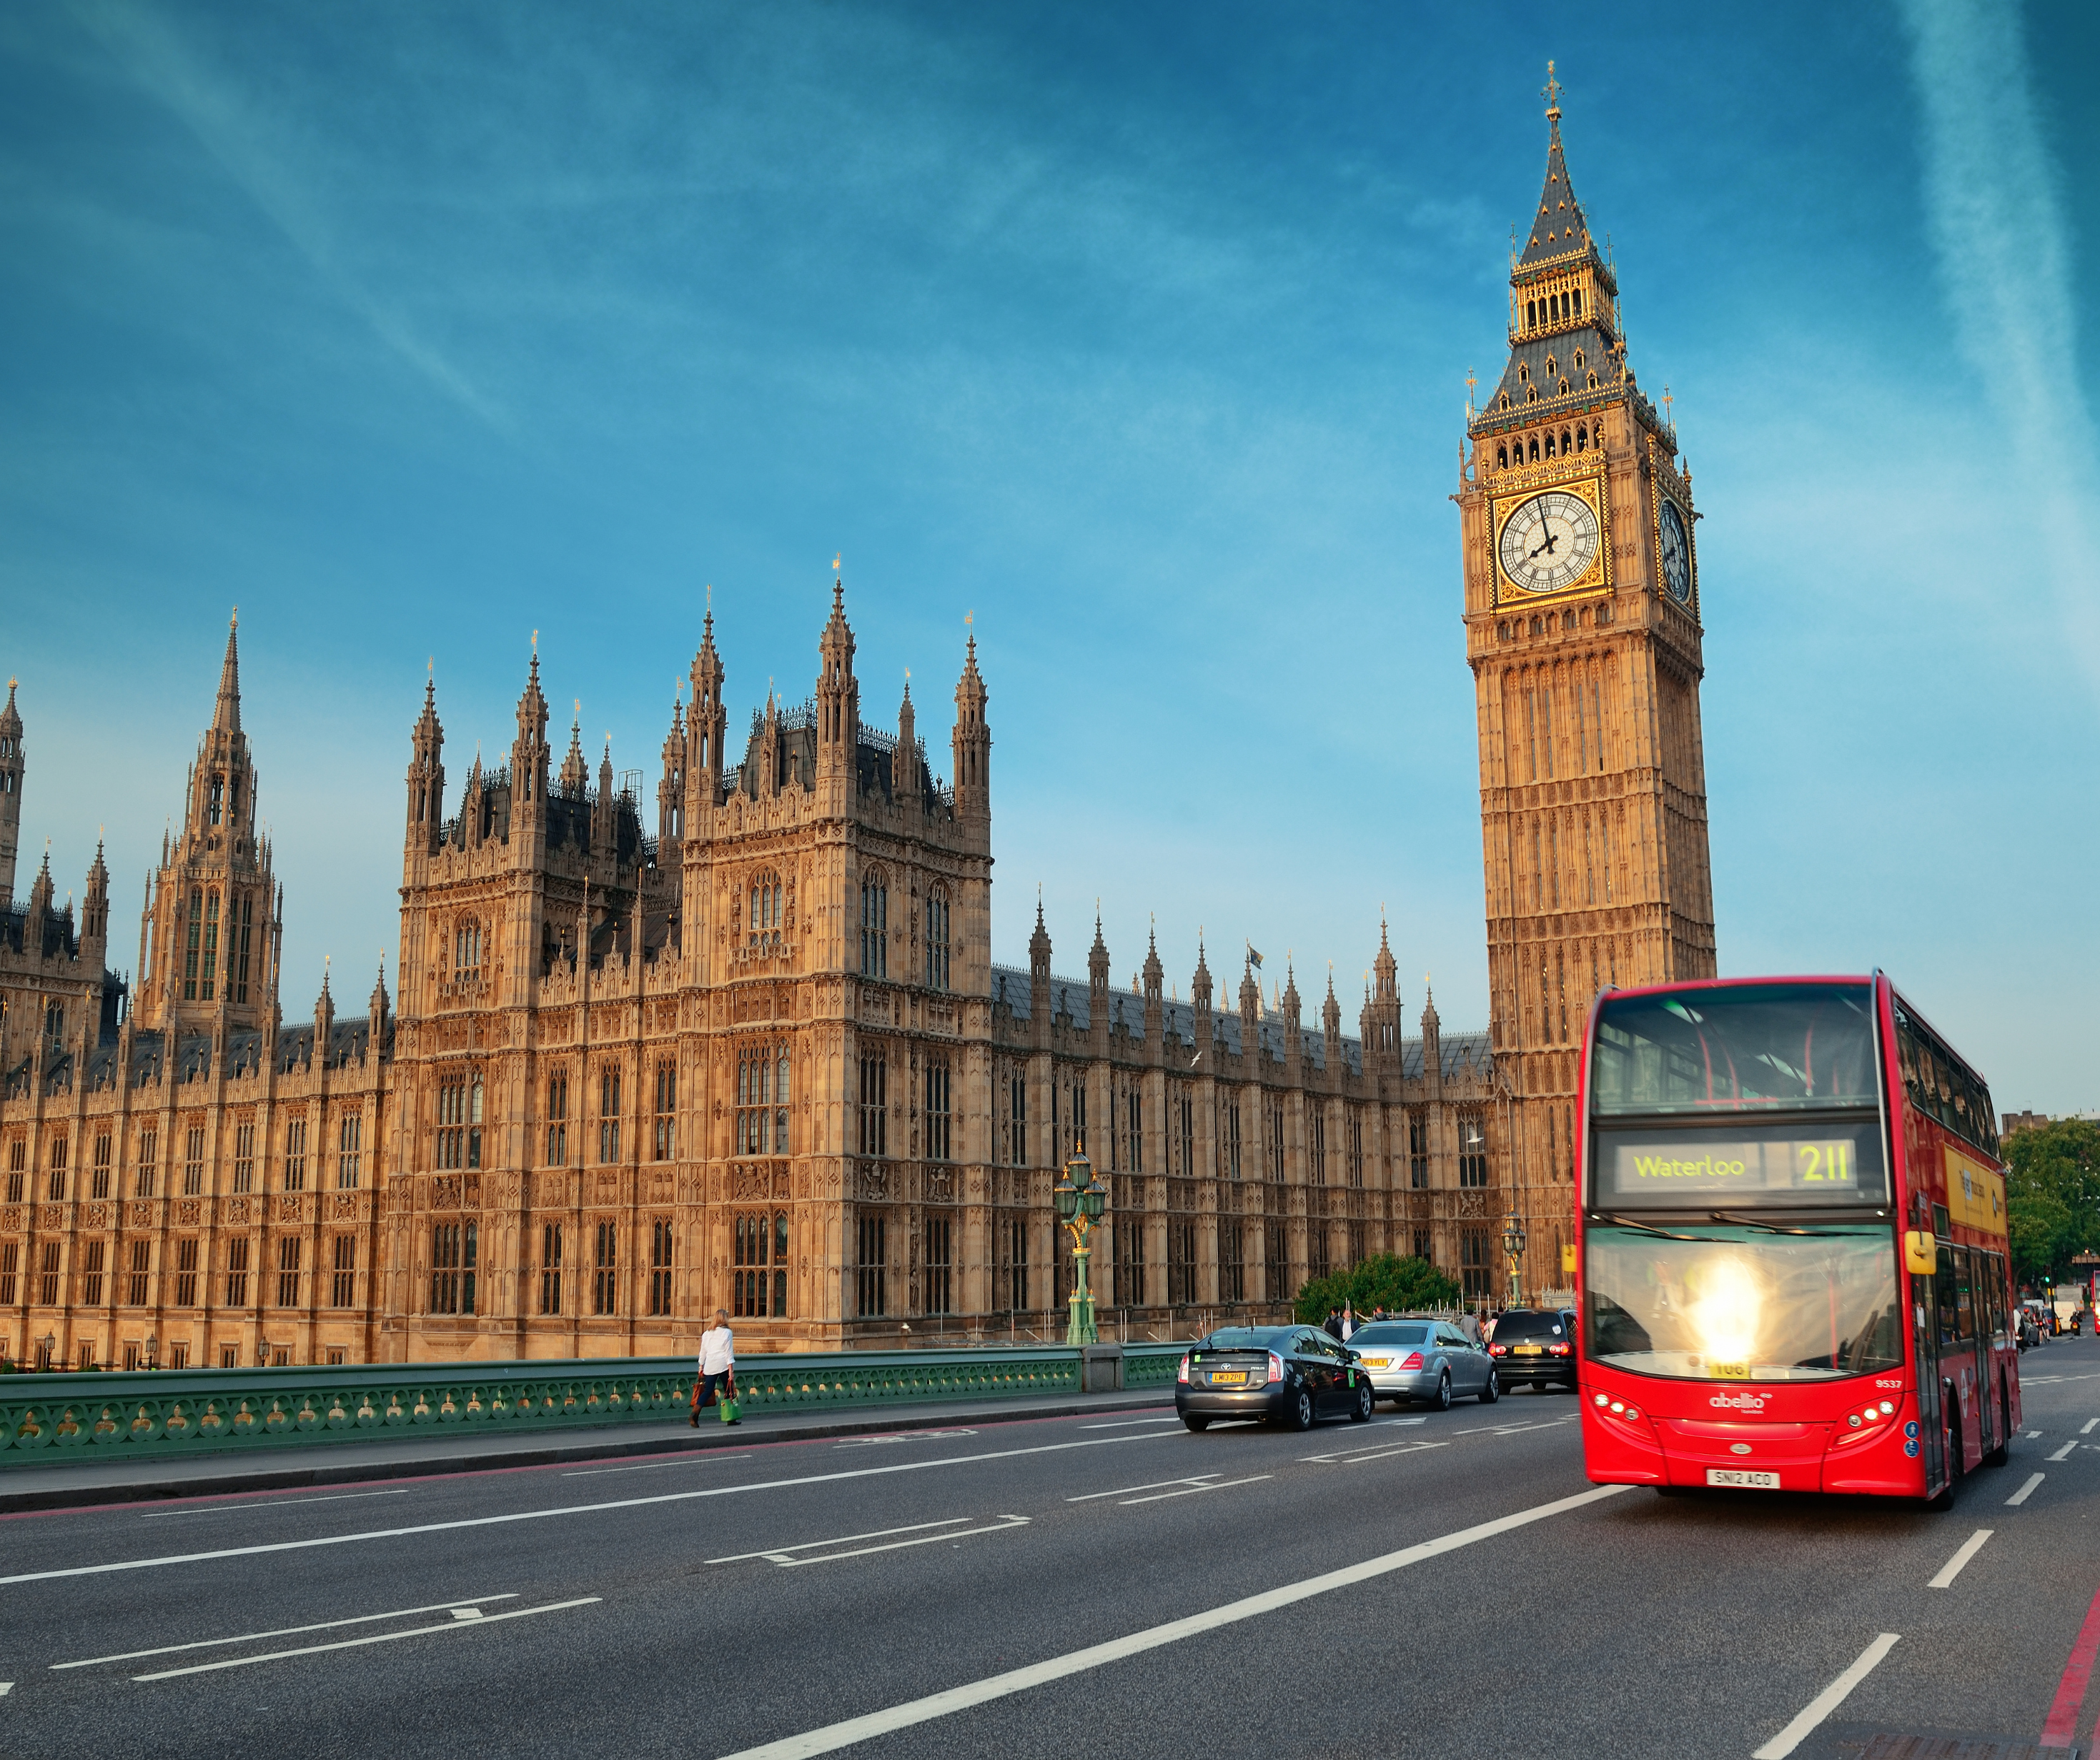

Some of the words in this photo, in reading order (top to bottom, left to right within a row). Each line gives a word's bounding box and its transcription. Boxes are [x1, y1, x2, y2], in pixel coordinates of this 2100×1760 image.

[1633, 1155, 1745, 1178] Waterloo
[1799, 1145, 1848, 1180] 211
[1876, 1380, 1902, 1388] 9537
[1715, 1472, 1743, 1484] SN12
